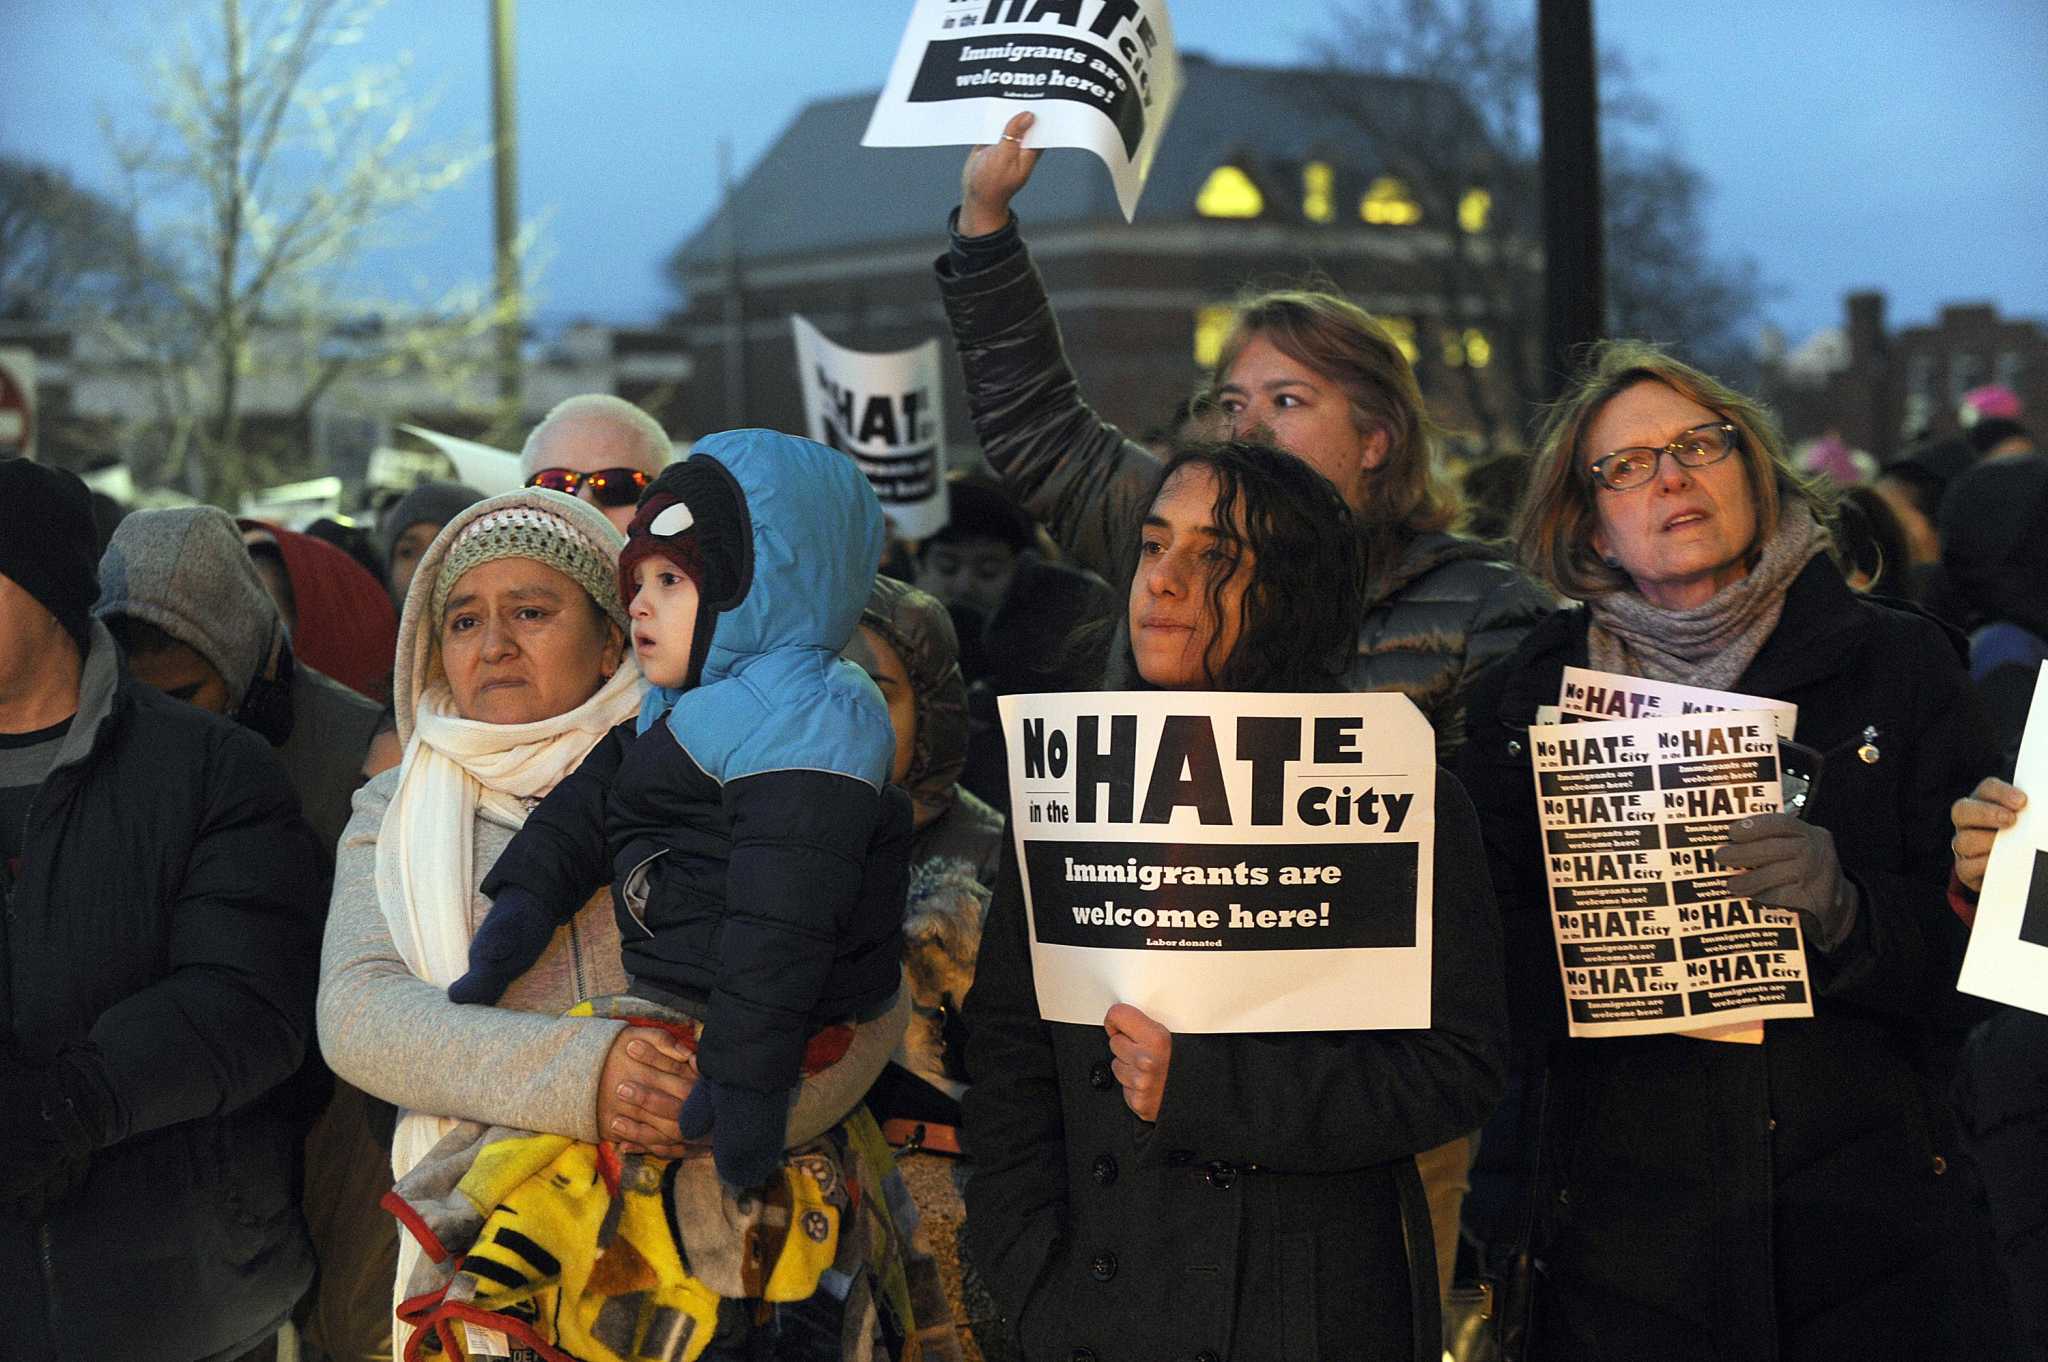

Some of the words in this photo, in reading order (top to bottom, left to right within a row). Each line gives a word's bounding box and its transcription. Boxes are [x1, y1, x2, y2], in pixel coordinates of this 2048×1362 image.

[959, 42, 1087, 64] Immigrants
[1089, 55, 1127, 92] are
[956, 68, 1047, 87] welcome
[1048, 69, 1115, 104] here!
[1566, 683, 1584, 699] No
[1586, 686, 1661, 719] HATE
[1658, 732, 1679, 748] No
[1682, 725, 1759, 757] HATE
[1537, 741, 1556, 757] No
[1558, 735, 1635, 766] HATE
[1745, 743, 1773, 754] City
[1620, 752, 1650, 763] City
[1023, 717, 1068, 780] No
[1075, 714, 1364, 825] HATE
[1678, 761, 1741, 774] Immigrants
[1556, 771, 1616, 781] Immigrants
[1682, 772, 1730, 784] welcome
[1560, 782, 1606, 791] welcome
[1664, 793, 1684, 808] No
[1687, 785, 1765, 817] HATE
[1029, 800, 1041, 823] in
[1046, 800, 1069, 823] the
[1296, 785, 1415, 833] City
[1544, 800, 1564, 814] No
[1566, 795, 1641, 824] HATE
[1627, 812, 1656, 822] City
[1564, 830, 1623, 839] Immigrants
[1568, 841, 1612, 849] welcome
[1670, 851, 1691, 866] No
[1551, 857, 1571, 872] No
[1573, 853, 1648, 881] HATE
[1064, 857, 1269, 890] Immigrants
[1278, 864, 1342, 885] are
[1634, 870, 1662, 880] City
[1572, 888, 1630, 897] Immigrants
[1576, 898, 1620, 906] welcome
[1072, 901, 1219, 929] welcome
[1228, 901, 1330, 929] here!
[1678, 907, 1699, 922] No
[1764, 914, 1793, 925] City
[1559, 915, 1579, 929] No
[1581, 910, 1655, 938] HATE
[1641, 926, 1670, 936] City
[1146, 937, 1176, 947] Labor
[1178, 937, 1222, 948] donated
[1700, 931, 1761, 944] Immigrants
[1580, 944, 1638, 953] Immigrants
[1704, 942, 1750, 953] welcome
[1686, 962, 1708, 977] No
[1709, 953, 1786, 984] HATE
[1772, 968, 1800, 978] City
[1567, 970, 1587, 985] No
[1588, 966, 1664, 994] HATE
[1649, 982, 1679, 992] City
[1707, 985, 1768, 999] Immigrants
[1588, 1000, 1646, 1009] Immigrants
[1711, 996, 1759, 1008] welcome
[1591, 1010, 1636, 1019] welcome
